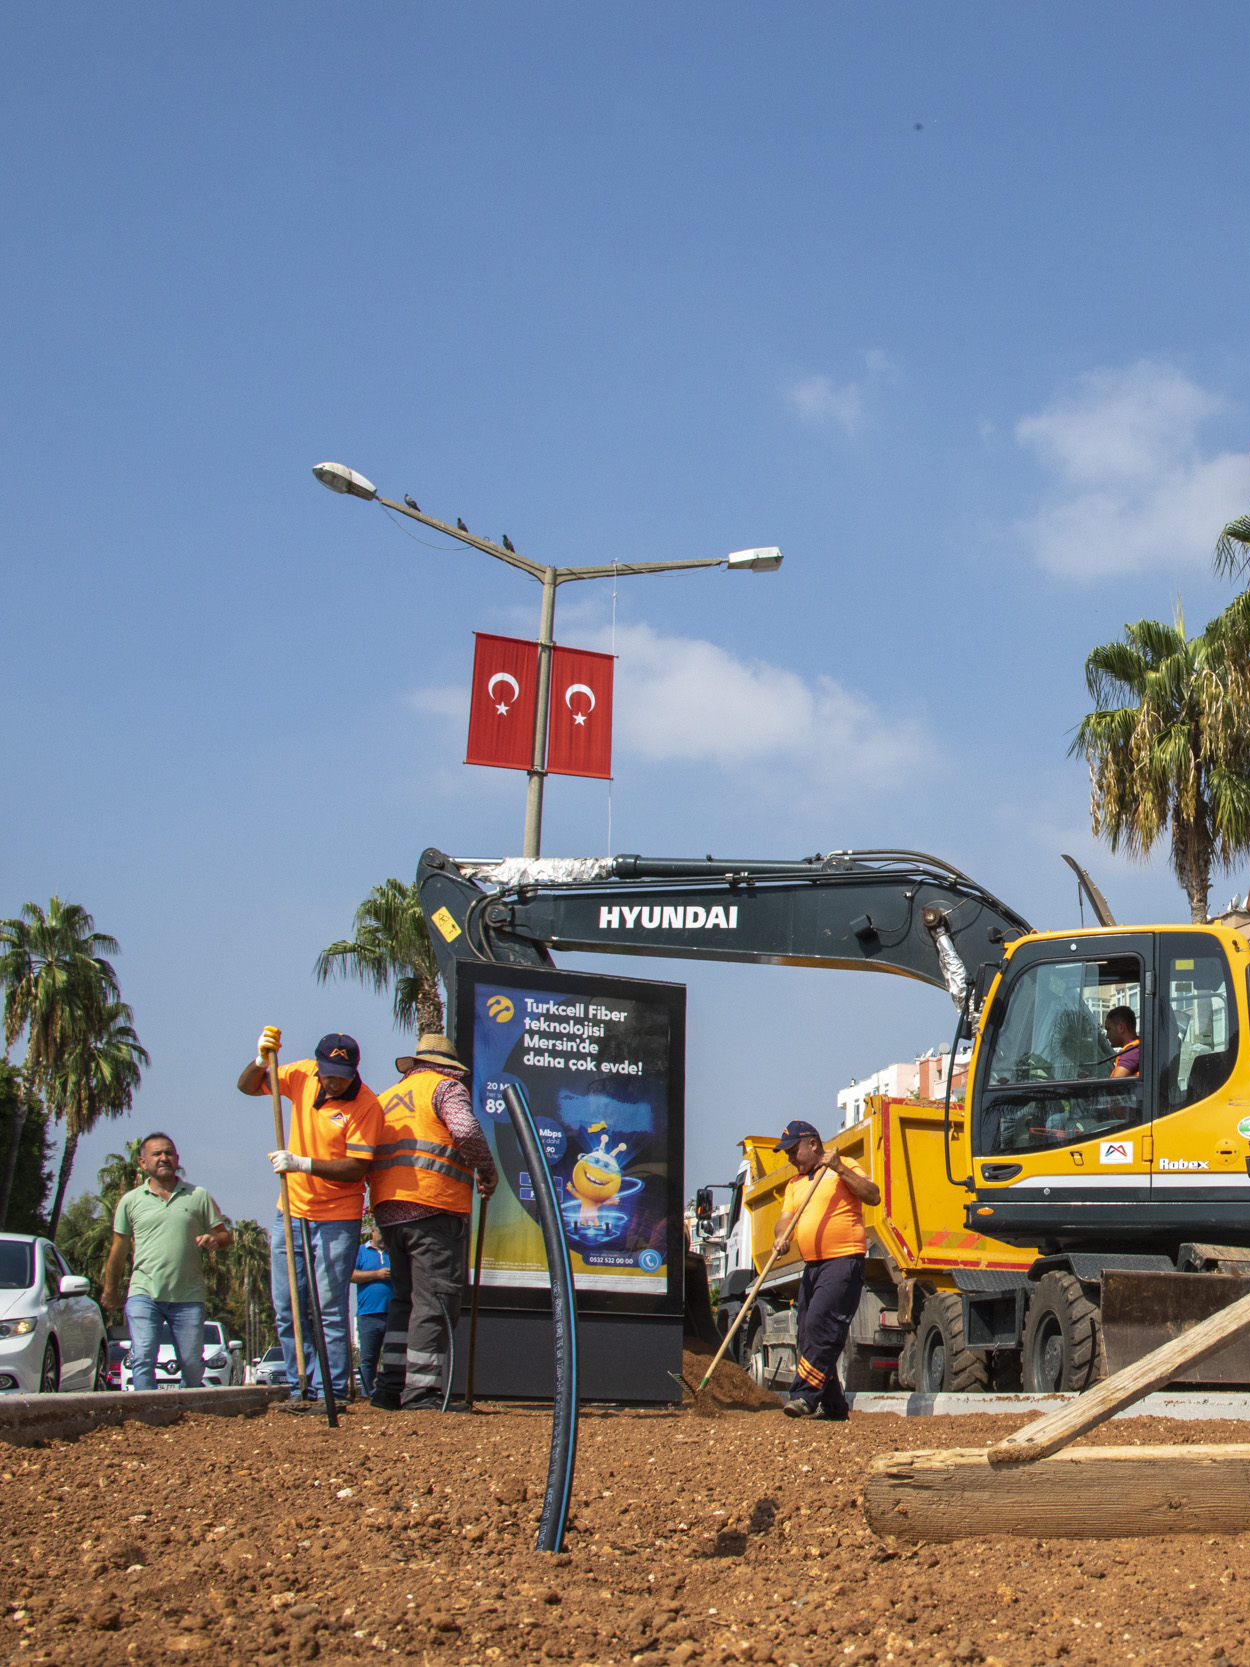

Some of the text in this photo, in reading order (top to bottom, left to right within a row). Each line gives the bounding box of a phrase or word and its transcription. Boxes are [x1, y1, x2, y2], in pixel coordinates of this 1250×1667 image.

[599, 906, 739, 928] HYUNDAI
[524, 998, 628, 1022] Turkcell Fiber
[523, 1017, 605, 1038] teknolojisi
[523, 1051, 643, 1076] daha çok evde!
[486, 1082, 498, 1090] 20
[539, 1128, 562, 1139] Mbps
[1159, 1158, 1210, 1170] Robex
